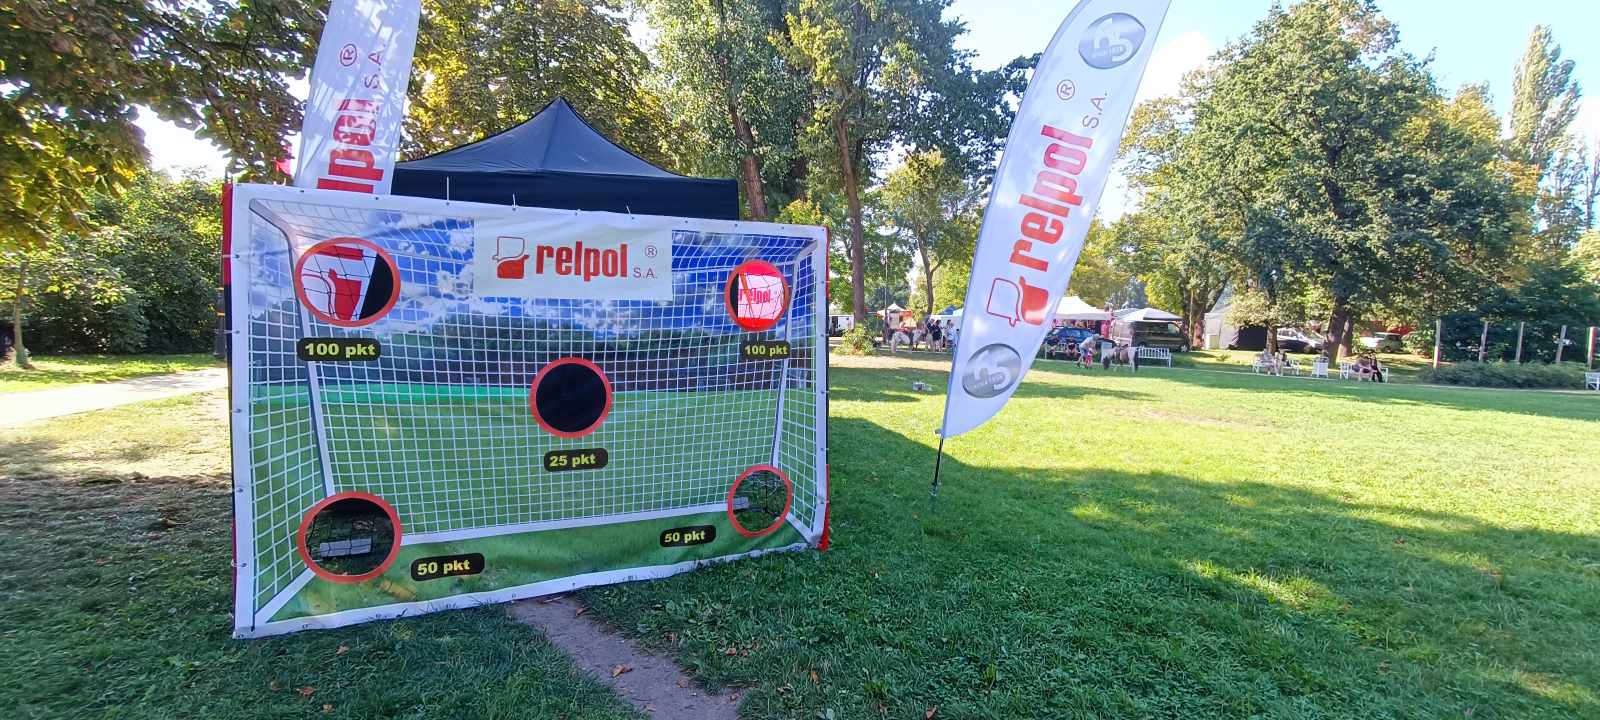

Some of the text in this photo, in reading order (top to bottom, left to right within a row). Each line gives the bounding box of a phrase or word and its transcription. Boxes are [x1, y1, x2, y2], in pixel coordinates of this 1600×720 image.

[1082, 92, 1108, 129] S.A.
[1009, 125, 1093, 272] relpol
[535, 241, 628, 282] relpol
[633, 267, 658, 280] S.A.
[304, 342, 376, 359] 100 pkt
[744, 343, 788, 357] 100 pkt
[549, 452, 597, 469] 25 pkt
[665, 529, 706, 544] 50 pkt
[417, 558, 470, 575] 50 pkt
